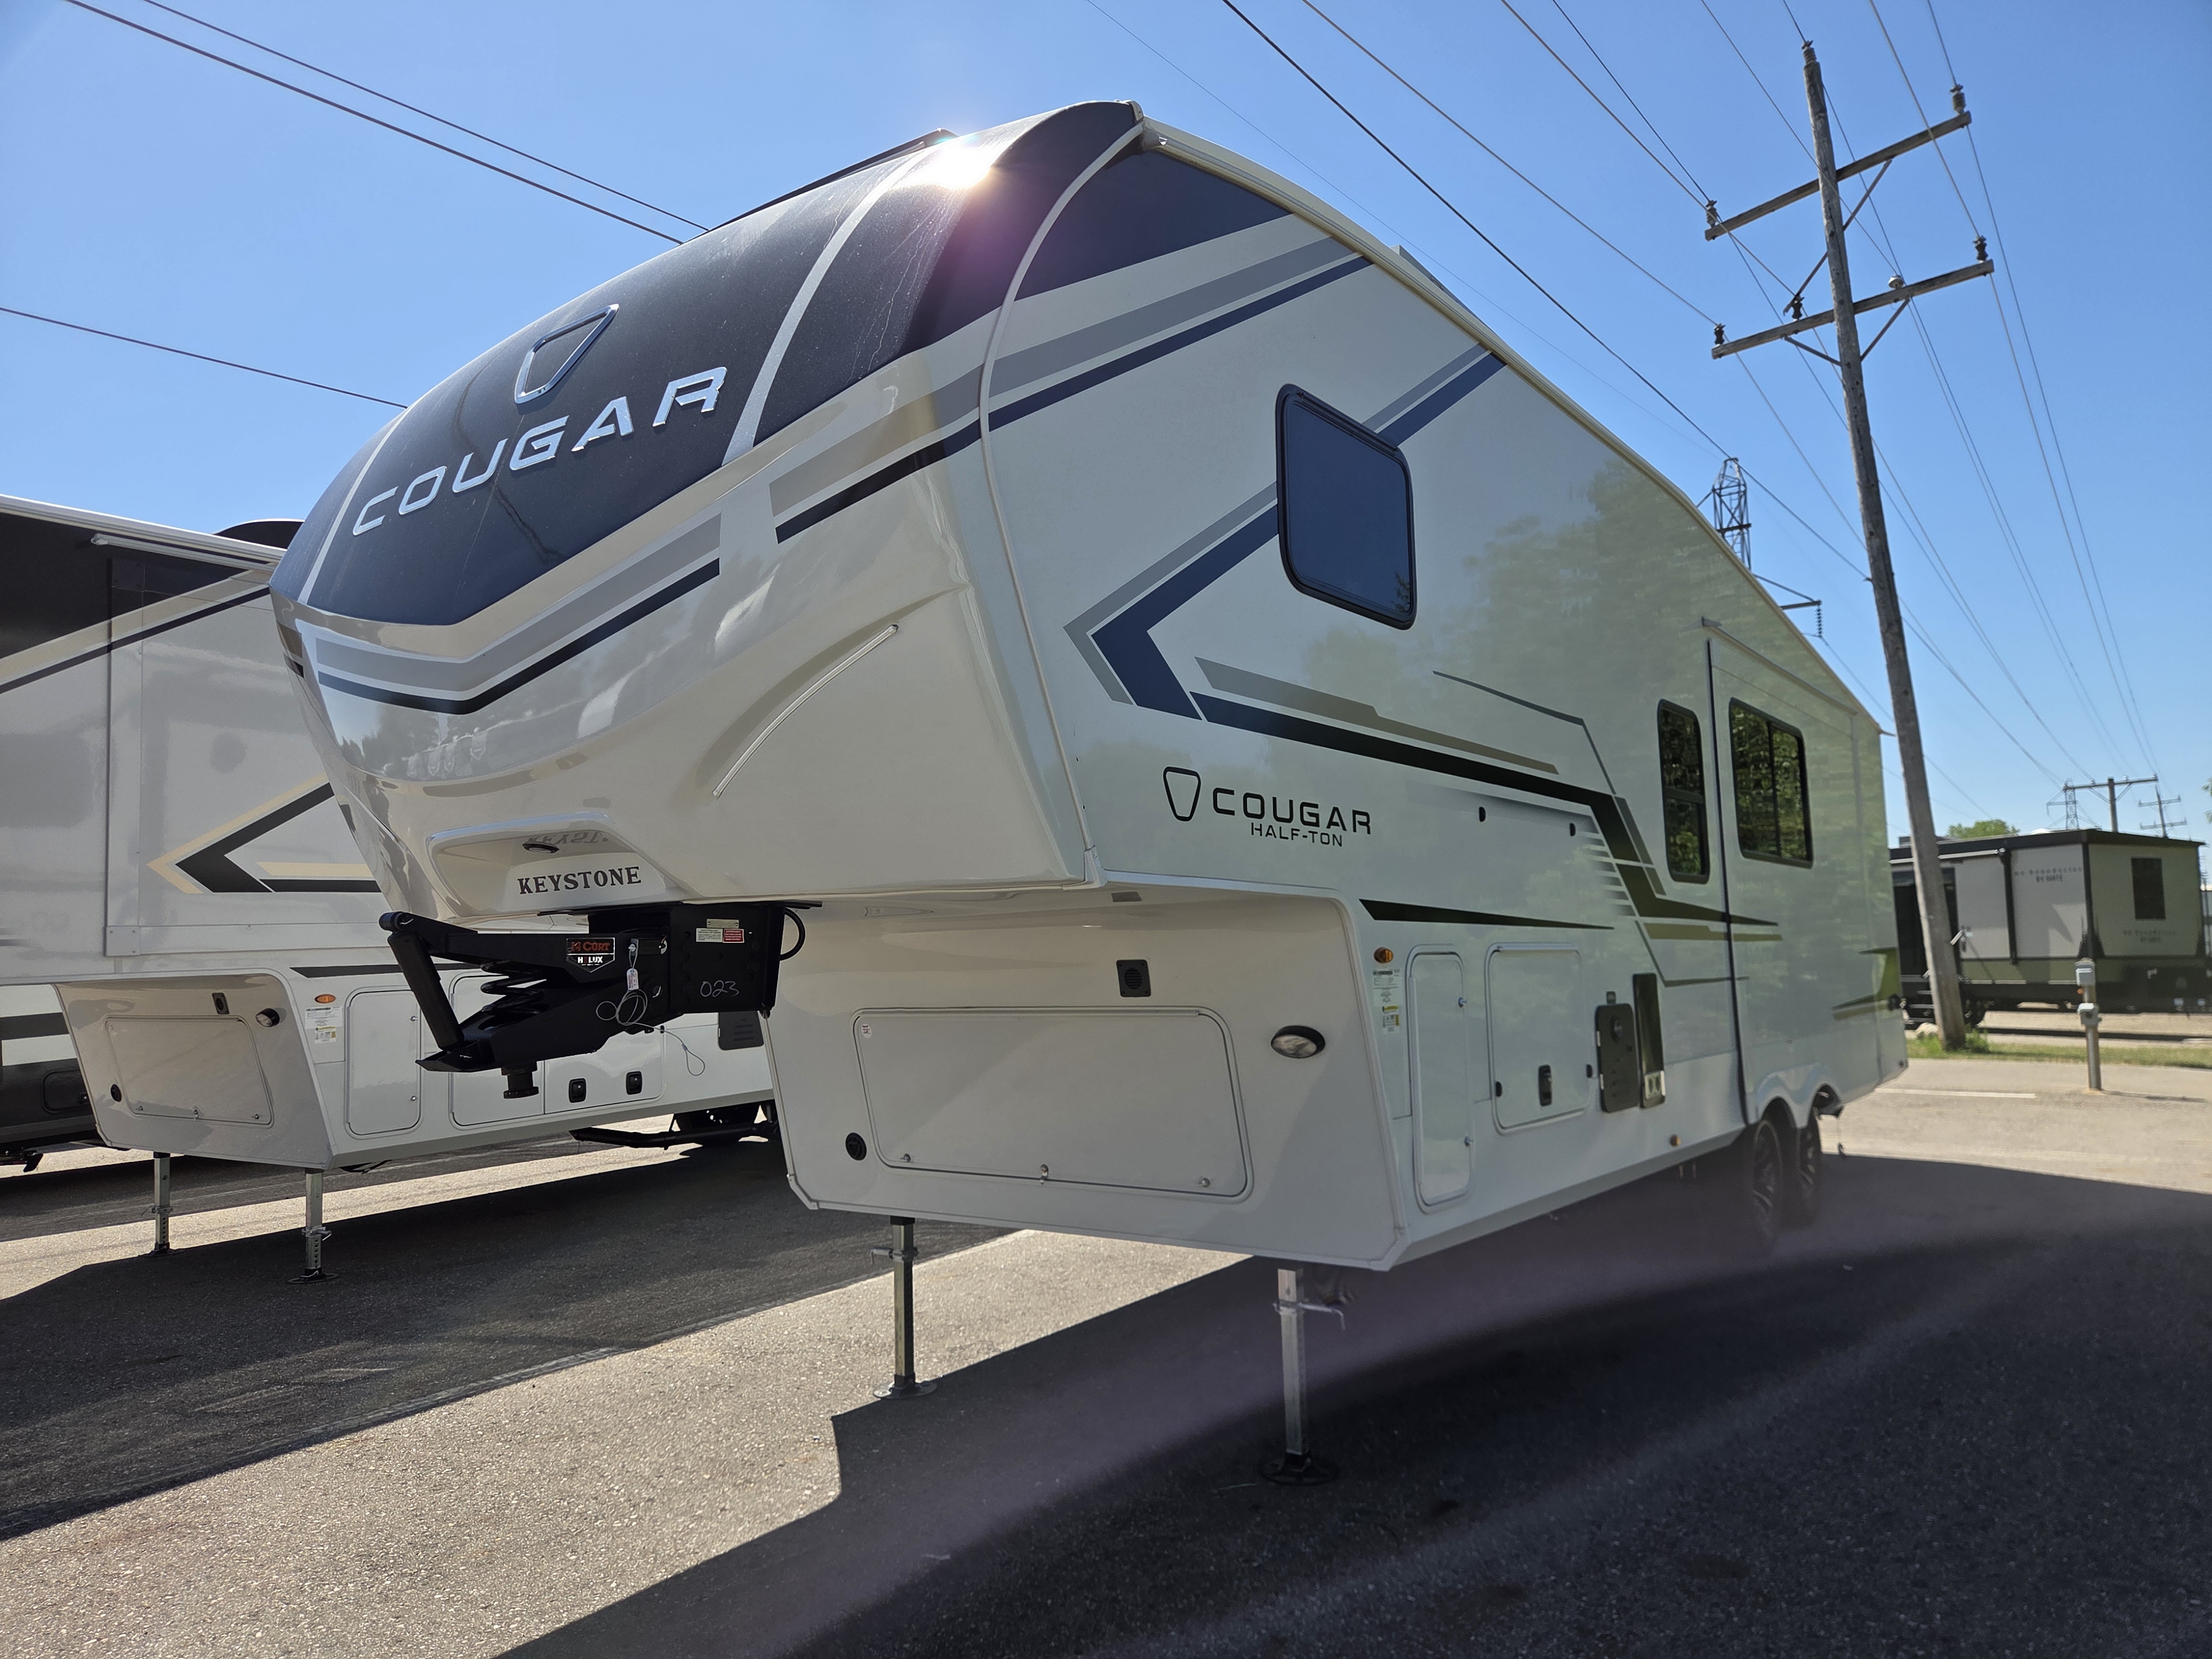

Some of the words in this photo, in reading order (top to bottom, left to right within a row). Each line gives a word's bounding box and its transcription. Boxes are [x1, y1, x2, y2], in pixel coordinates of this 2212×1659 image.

[353, 367, 727, 535] COUGAR
[1213, 787, 1371, 834] COUGAR
[1251, 822, 1342, 847] HALF-TON
[517, 866, 641, 894] KEYSTONE
[700, 980, 739, 997] 023
